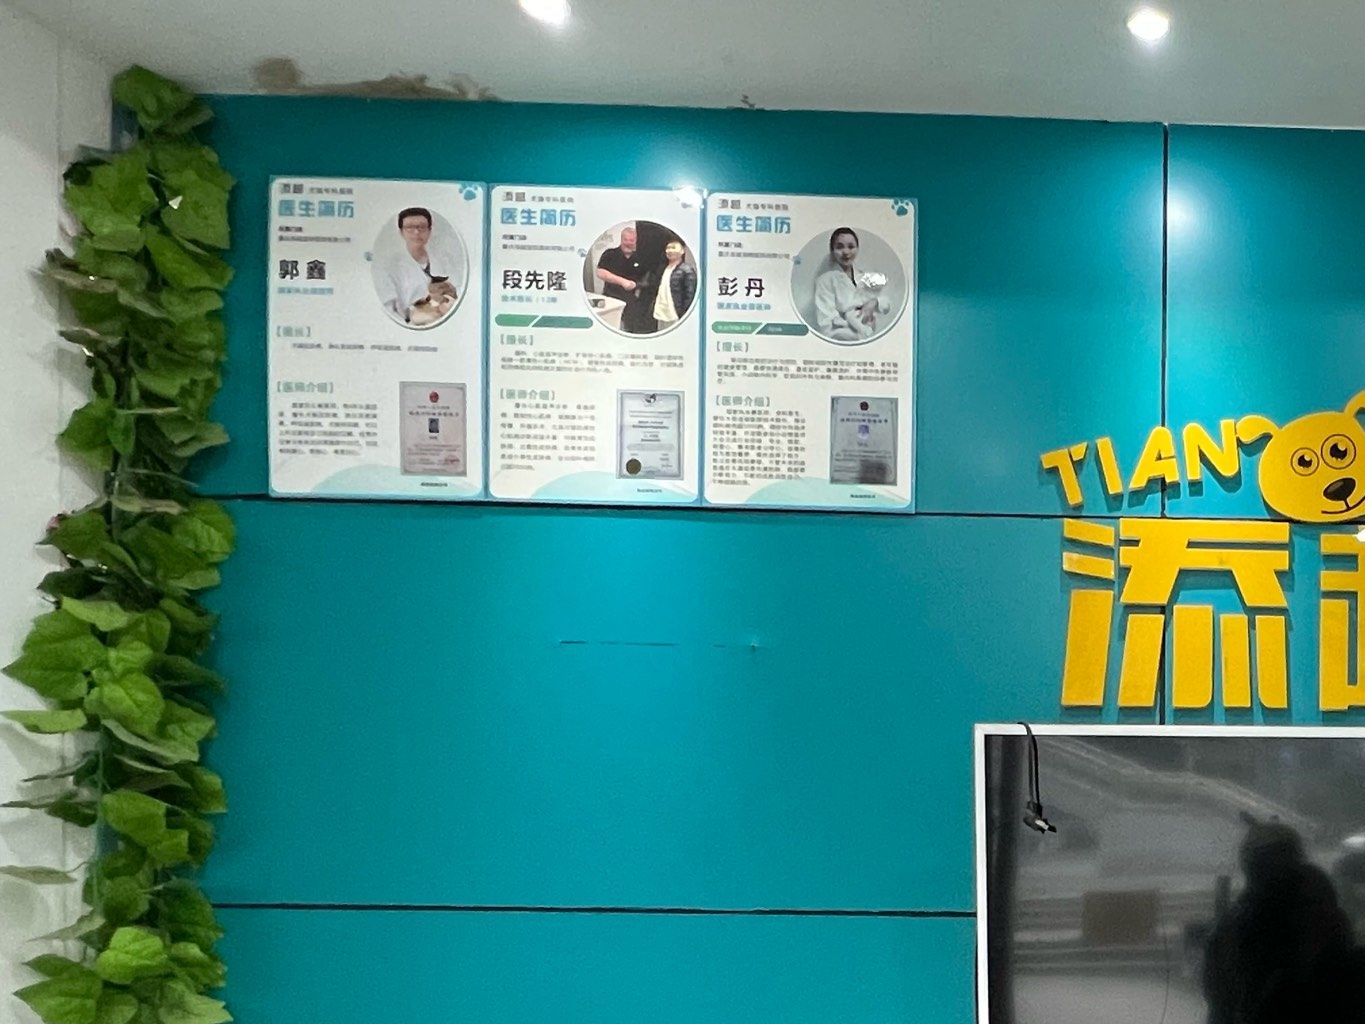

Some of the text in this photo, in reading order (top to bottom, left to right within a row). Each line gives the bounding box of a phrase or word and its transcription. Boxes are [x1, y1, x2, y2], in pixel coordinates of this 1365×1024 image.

[501, 207, 576, 227] 医生简历
[716, 214, 791, 234] 医生简历
[278, 259, 326, 280] 郭鑫
[502, 269, 567, 291] 段先隆
[717, 276, 765, 298] 彭丹
[1040, 419, 1240, 508] TIAN
